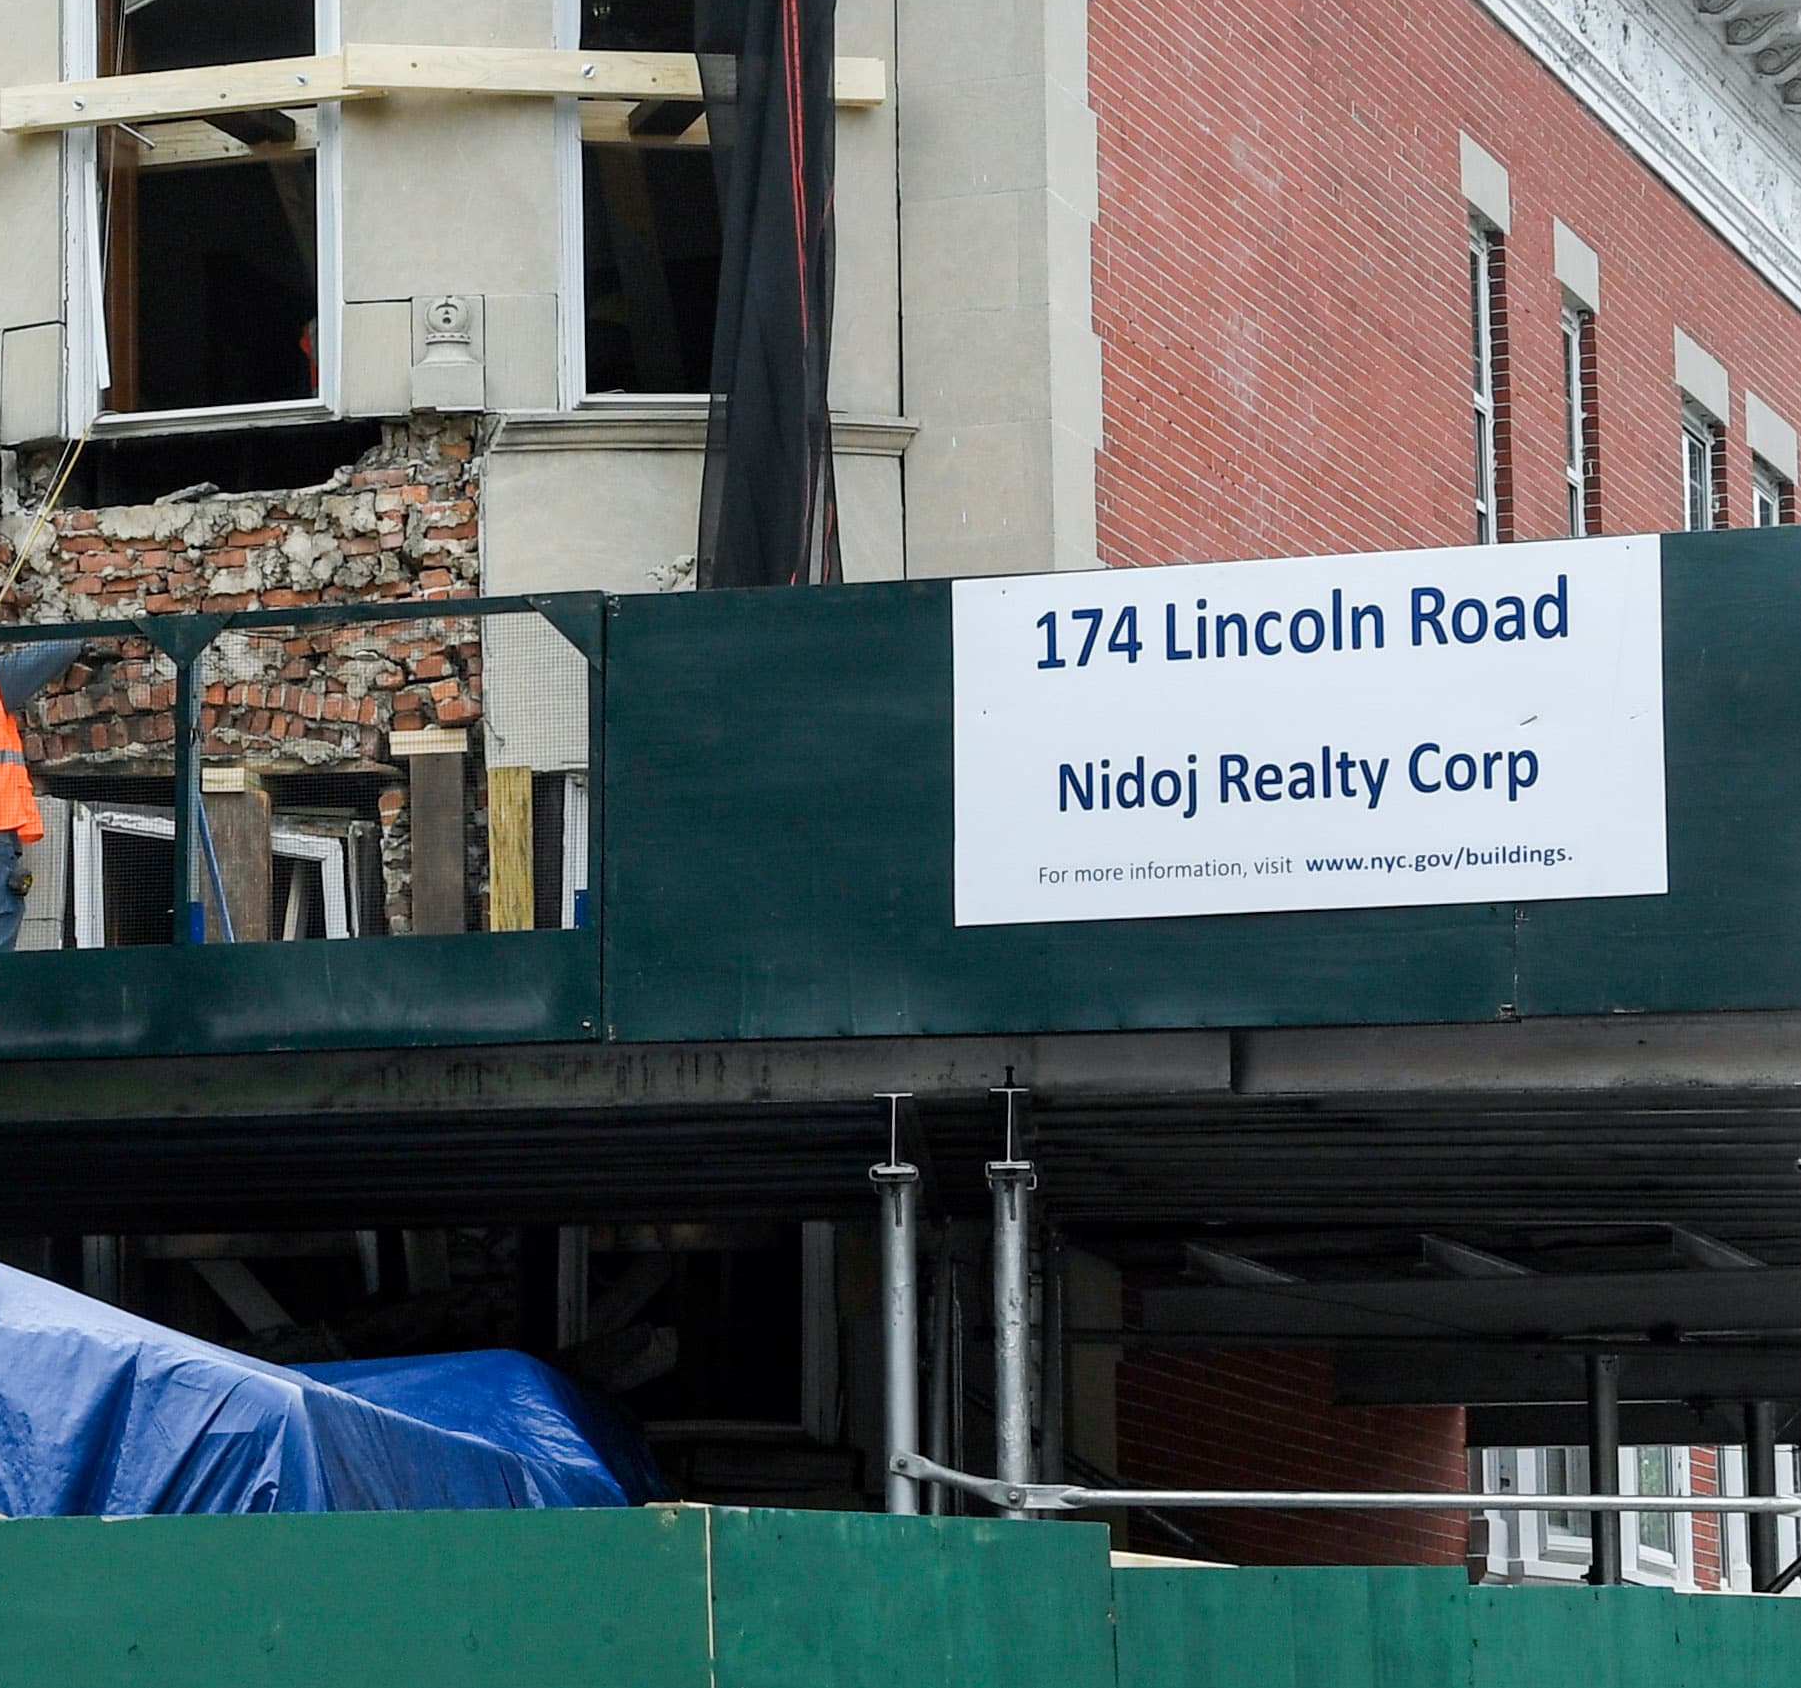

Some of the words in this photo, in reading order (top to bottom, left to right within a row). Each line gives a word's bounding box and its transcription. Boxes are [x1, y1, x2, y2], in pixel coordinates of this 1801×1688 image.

[1036, 605, 1144, 670] 174
[1165, 587, 1385, 662] Lincoln
[1410, 573, 1569, 647] Road
[1058, 753, 1198, 820] Nidoj
[1219, 745, 1390, 810] Realty
[1408, 742, 1539, 803] Corp
[1038, 865, 1069, 885] For
[1074, 867, 1124, 884] more
[1129, 859, 1249, 881] information,
[1253, 857, 1294, 876] visit
[1305, 844, 1573, 875] www.nyc.gov/buildings.
